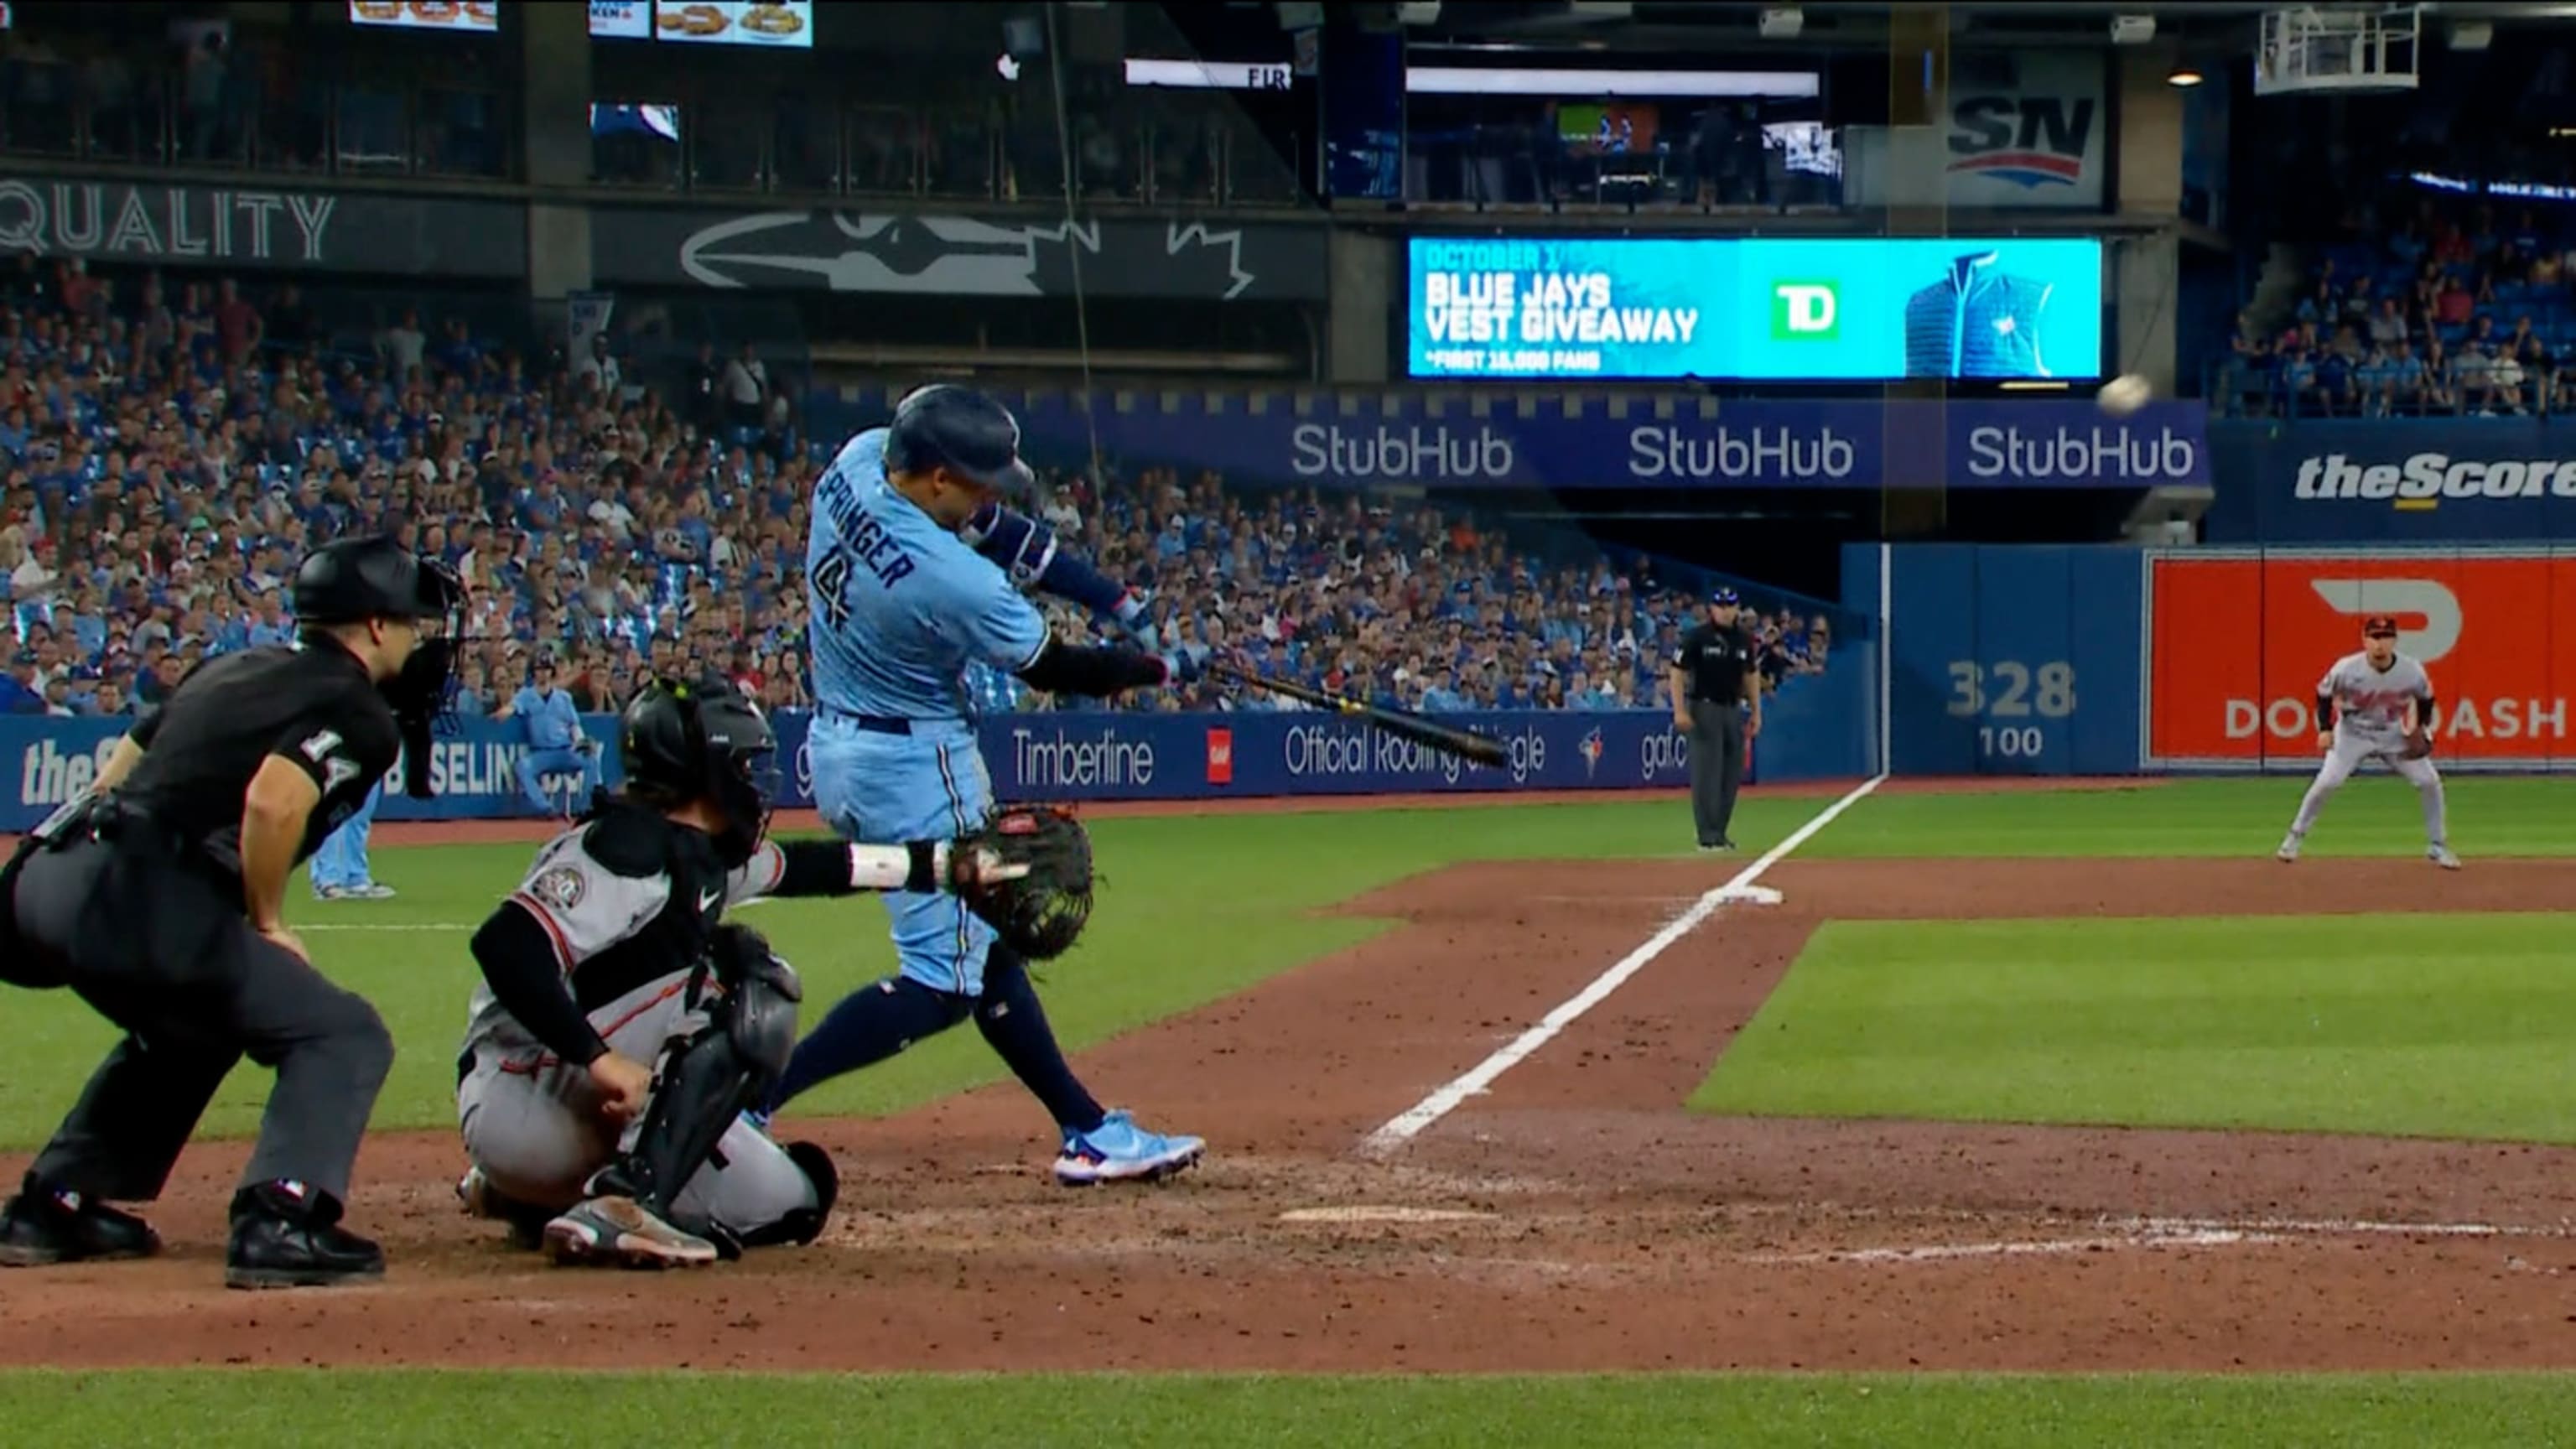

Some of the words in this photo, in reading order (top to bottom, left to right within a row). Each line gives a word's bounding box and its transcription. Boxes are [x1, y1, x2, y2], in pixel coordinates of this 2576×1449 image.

[1948, 96, 2094, 159] SN
[0, 180, 335, 260] QUALITY
[1426, 244, 1540, 269] OCTOBER
[1546, 246, 1561, 268] 1
[1426, 272, 1514, 307] BLUE
[1522, 273, 1611, 307] JAYS
[1777, 286, 1836, 332] TD
[1426, 308, 1514, 342] VEST
[1521, 308, 1698, 343] GIVEAWAY
[1552, 351, 1600, 371] FANS
[1292, 424, 1513, 476] StubHub
[1628, 427, 1853, 477] StubHub
[1969, 427, 2194, 477] StubHub
[1947, 660, 2077, 717] 328
[1980, 726, 2043, 757] 100
[2225, 698, 2566, 738] DOASH
[1013, 729, 1154, 786] Timberline
[1285, 724, 1368, 775] Official
